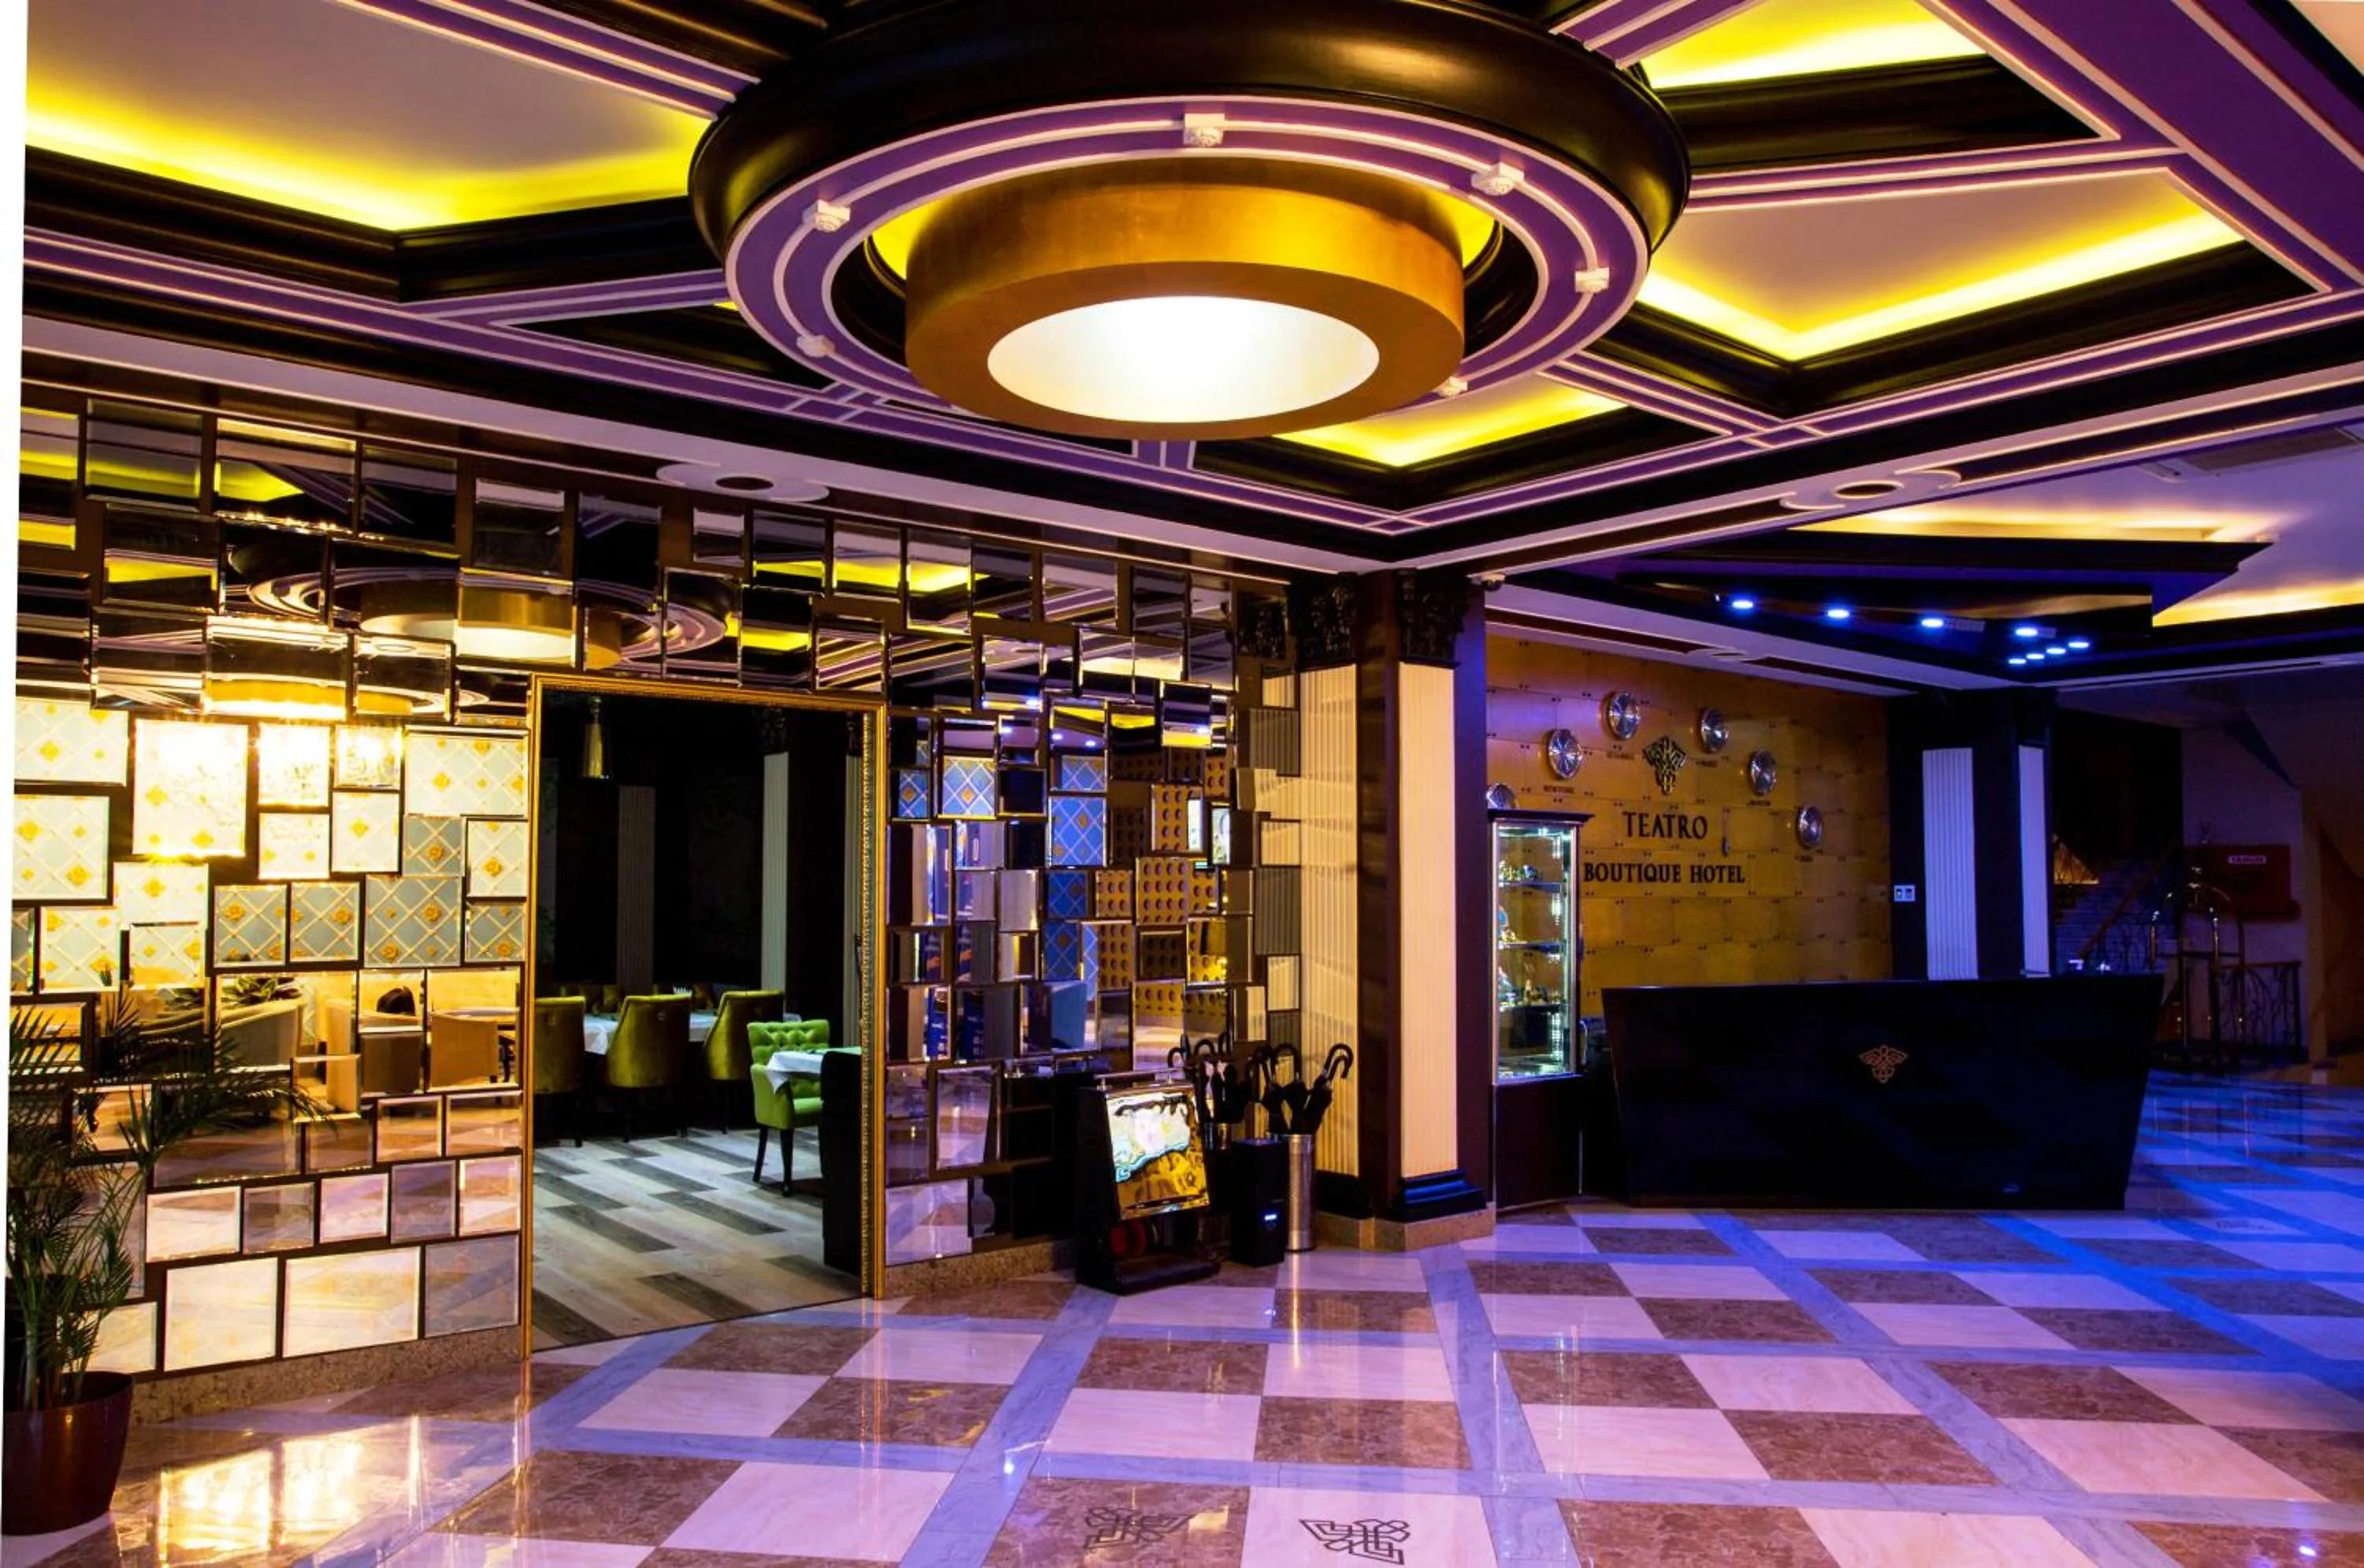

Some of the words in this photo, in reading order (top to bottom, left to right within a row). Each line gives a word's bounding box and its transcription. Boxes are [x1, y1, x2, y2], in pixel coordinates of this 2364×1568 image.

[1622, 812, 1708, 840] TEATRO
[1584, 862, 1682, 883] BOUTIQUE
[1689, 864, 1746, 884] HOTEL
